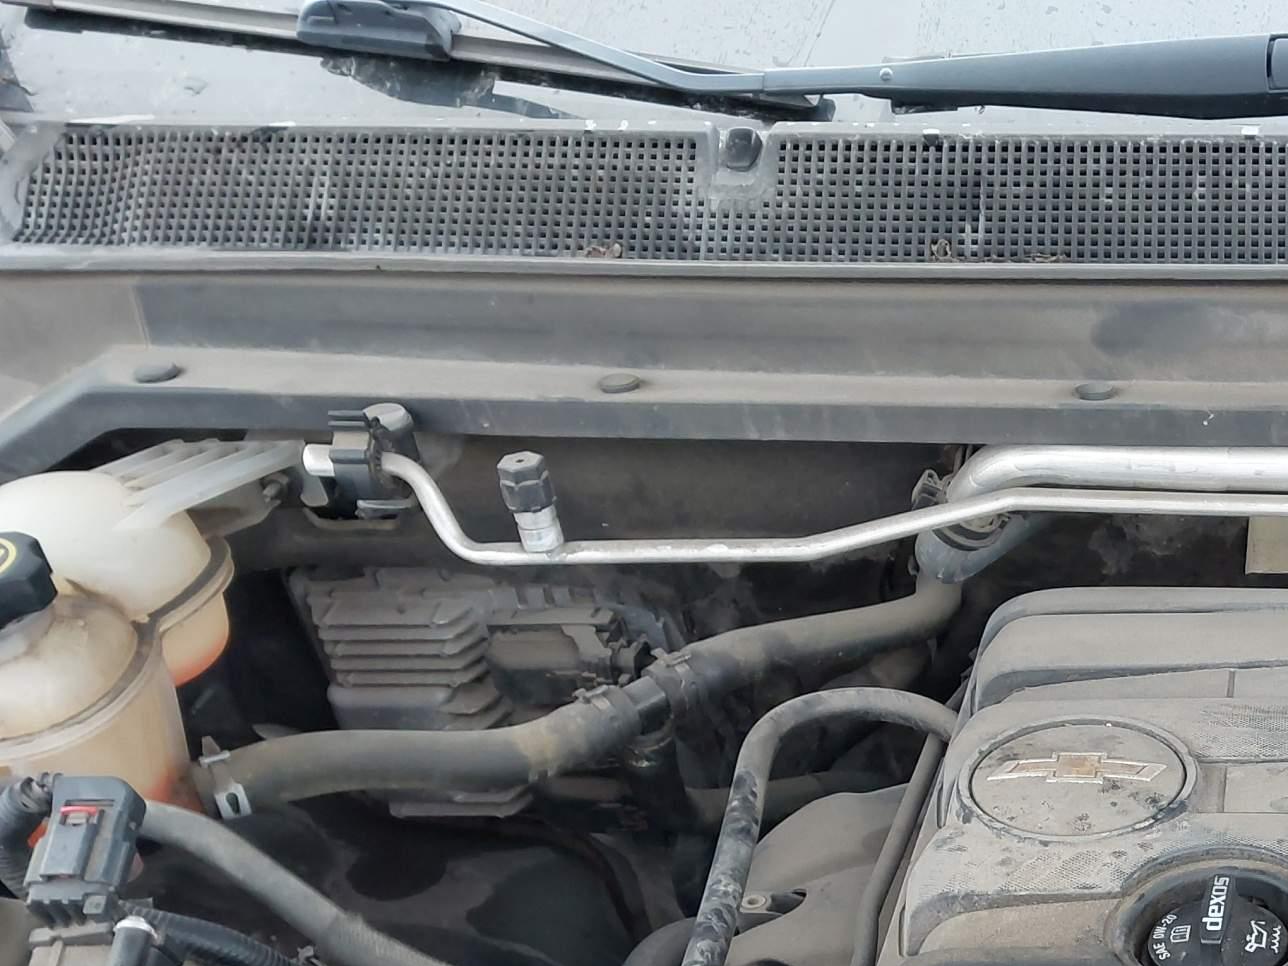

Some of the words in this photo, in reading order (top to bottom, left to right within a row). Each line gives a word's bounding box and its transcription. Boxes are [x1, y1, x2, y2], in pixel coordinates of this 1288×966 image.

[1202, 875, 1230, 931] dexos
[1152, 913, 1178, 940] 0W-20
[1152, 942, 1171, 960] SAE
